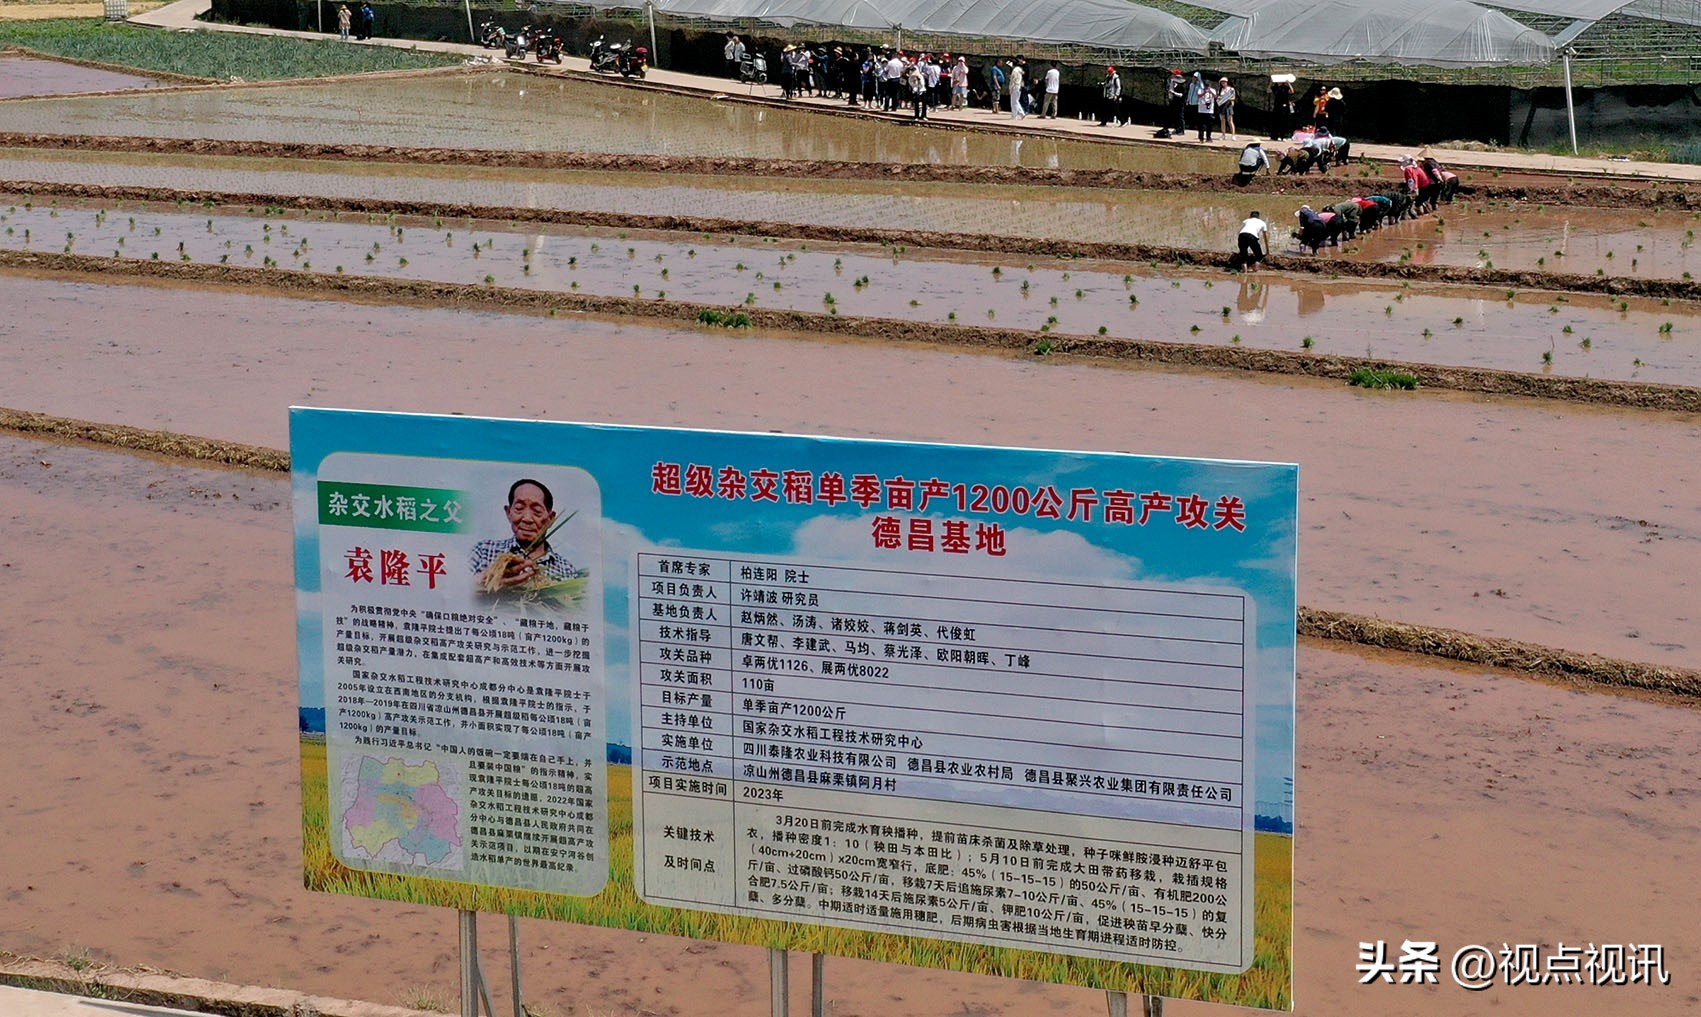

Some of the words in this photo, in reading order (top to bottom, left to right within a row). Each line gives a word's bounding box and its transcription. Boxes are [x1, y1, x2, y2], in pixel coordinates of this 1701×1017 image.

[651, 462, 1247, 534] 超级杂交稻单季亩产1200公斤高产攻关
[329, 492, 463, 524] 杂交水稻之父
[872, 516, 1007, 557] 德昌基地
[344, 546, 448, 589] 袁隆平
[658, 560, 711, 577] 首席专家
[741, 566, 777, 582] 柏连阳
[784, 569, 809, 584] 院士
[652, 581, 717, 599] 项目负责人
[740, 588, 778, 604] 许靖波
[782, 591, 819, 607] 研究员
[652, 602, 717, 621] 基地负责人
[659, 625, 712, 642] 技术指导
[659, 647, 712, 663] 攻关品种
[742, 654, 889, 679] 卓两优1126、展两优8022
[660, 669, 713, 686] 攻关面积
[742, 677, 775, 692] 110亩
[661, 690, 713, 708] 目标产量
[742, 698, 847, 720] 单季亩产1200公斤
[661, 712, 713, 729] 主持单位
[661, 733, 713, 751] 实施单位
[743, 720, 923, 749] 国家杂交水稻工程技术研究中心
[661, 755, 713, 773] 示范地点
[743, 743, 896, 770] 四川泰隆农业科技有限公司
[907, 757, 1013, 781] 德昌县农业农村局
[1024, 768, 1232, 802] 德昌县聚兴农业集团有限责任公司
[648, 775, 727, 796] 项目实施时间
[743, 764, 896, 792] 凉山州德昌县麻栗镇阿月村
[743, 786, 784, 803] 2023年
[470, 800, 594, 821] 杂交水稻工程技术研究中心成都
[470, 813, 594, 834] 分中心与德昌县人民政府共同在
[663, 825, 715, 843] 关键技术
[664, 855, 716, 873] 及时间点
